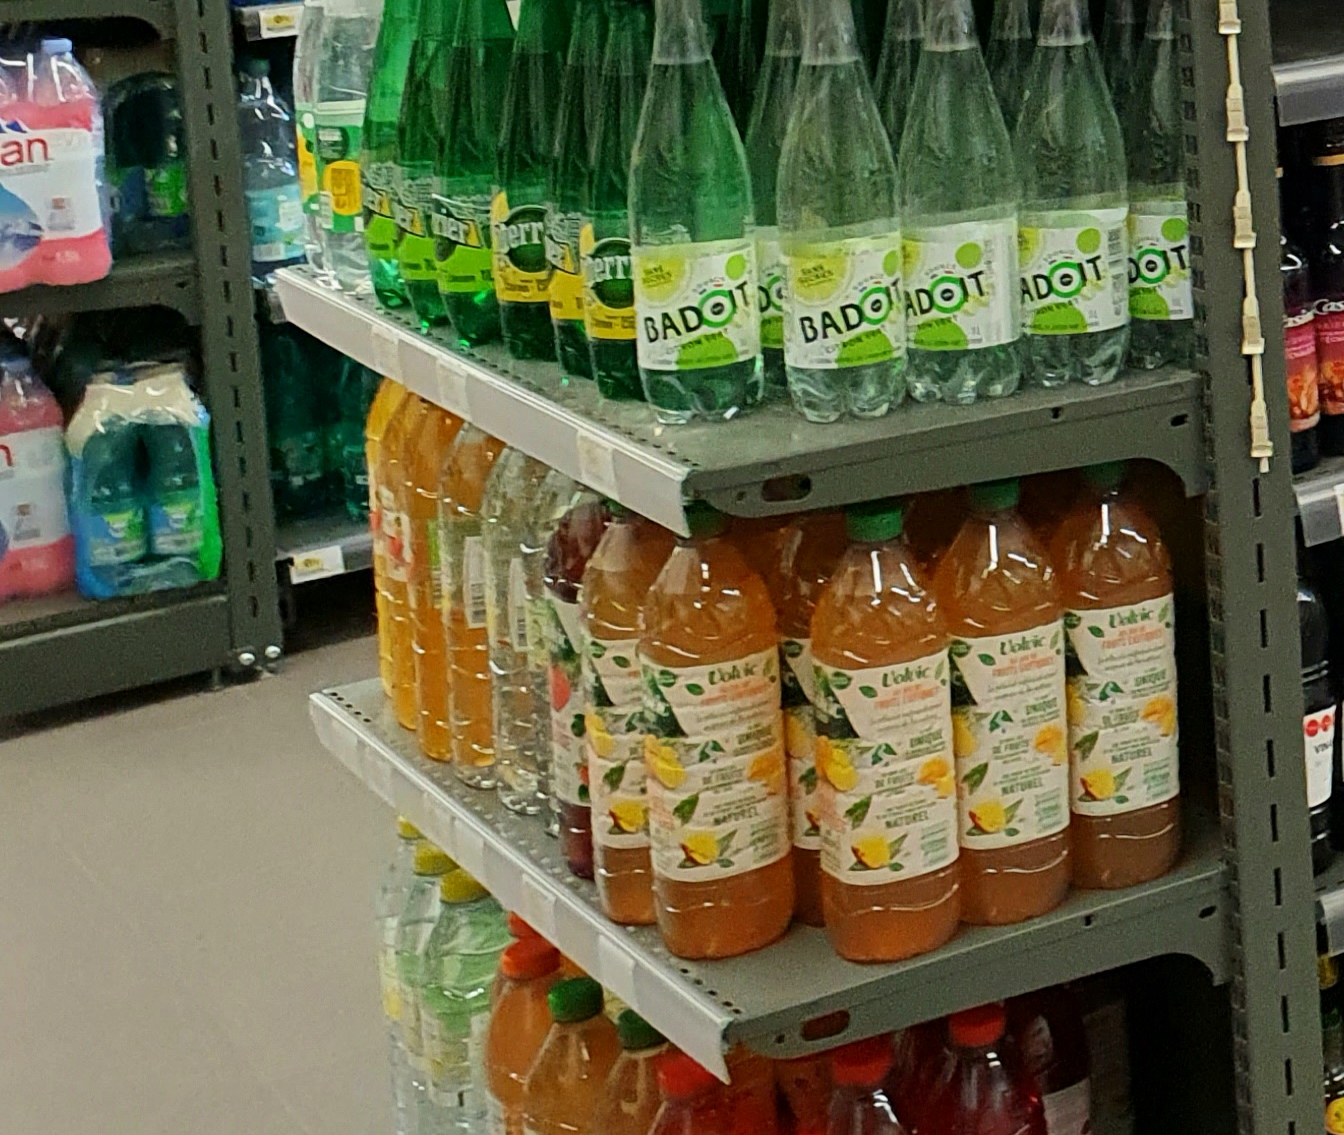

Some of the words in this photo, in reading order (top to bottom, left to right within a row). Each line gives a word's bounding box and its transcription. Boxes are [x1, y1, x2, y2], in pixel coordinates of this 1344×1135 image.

[1020, 255, 1102, 303] ADOIT
[1128, 245, 1187, 284] DOIT
[644, 280, 750, 344] BADOIT
[1111, 747, 1153, 764] NATUREL
[1001, 777, 1044, 797] NATUREL
[885, 810, 929, 829] NATUREL
